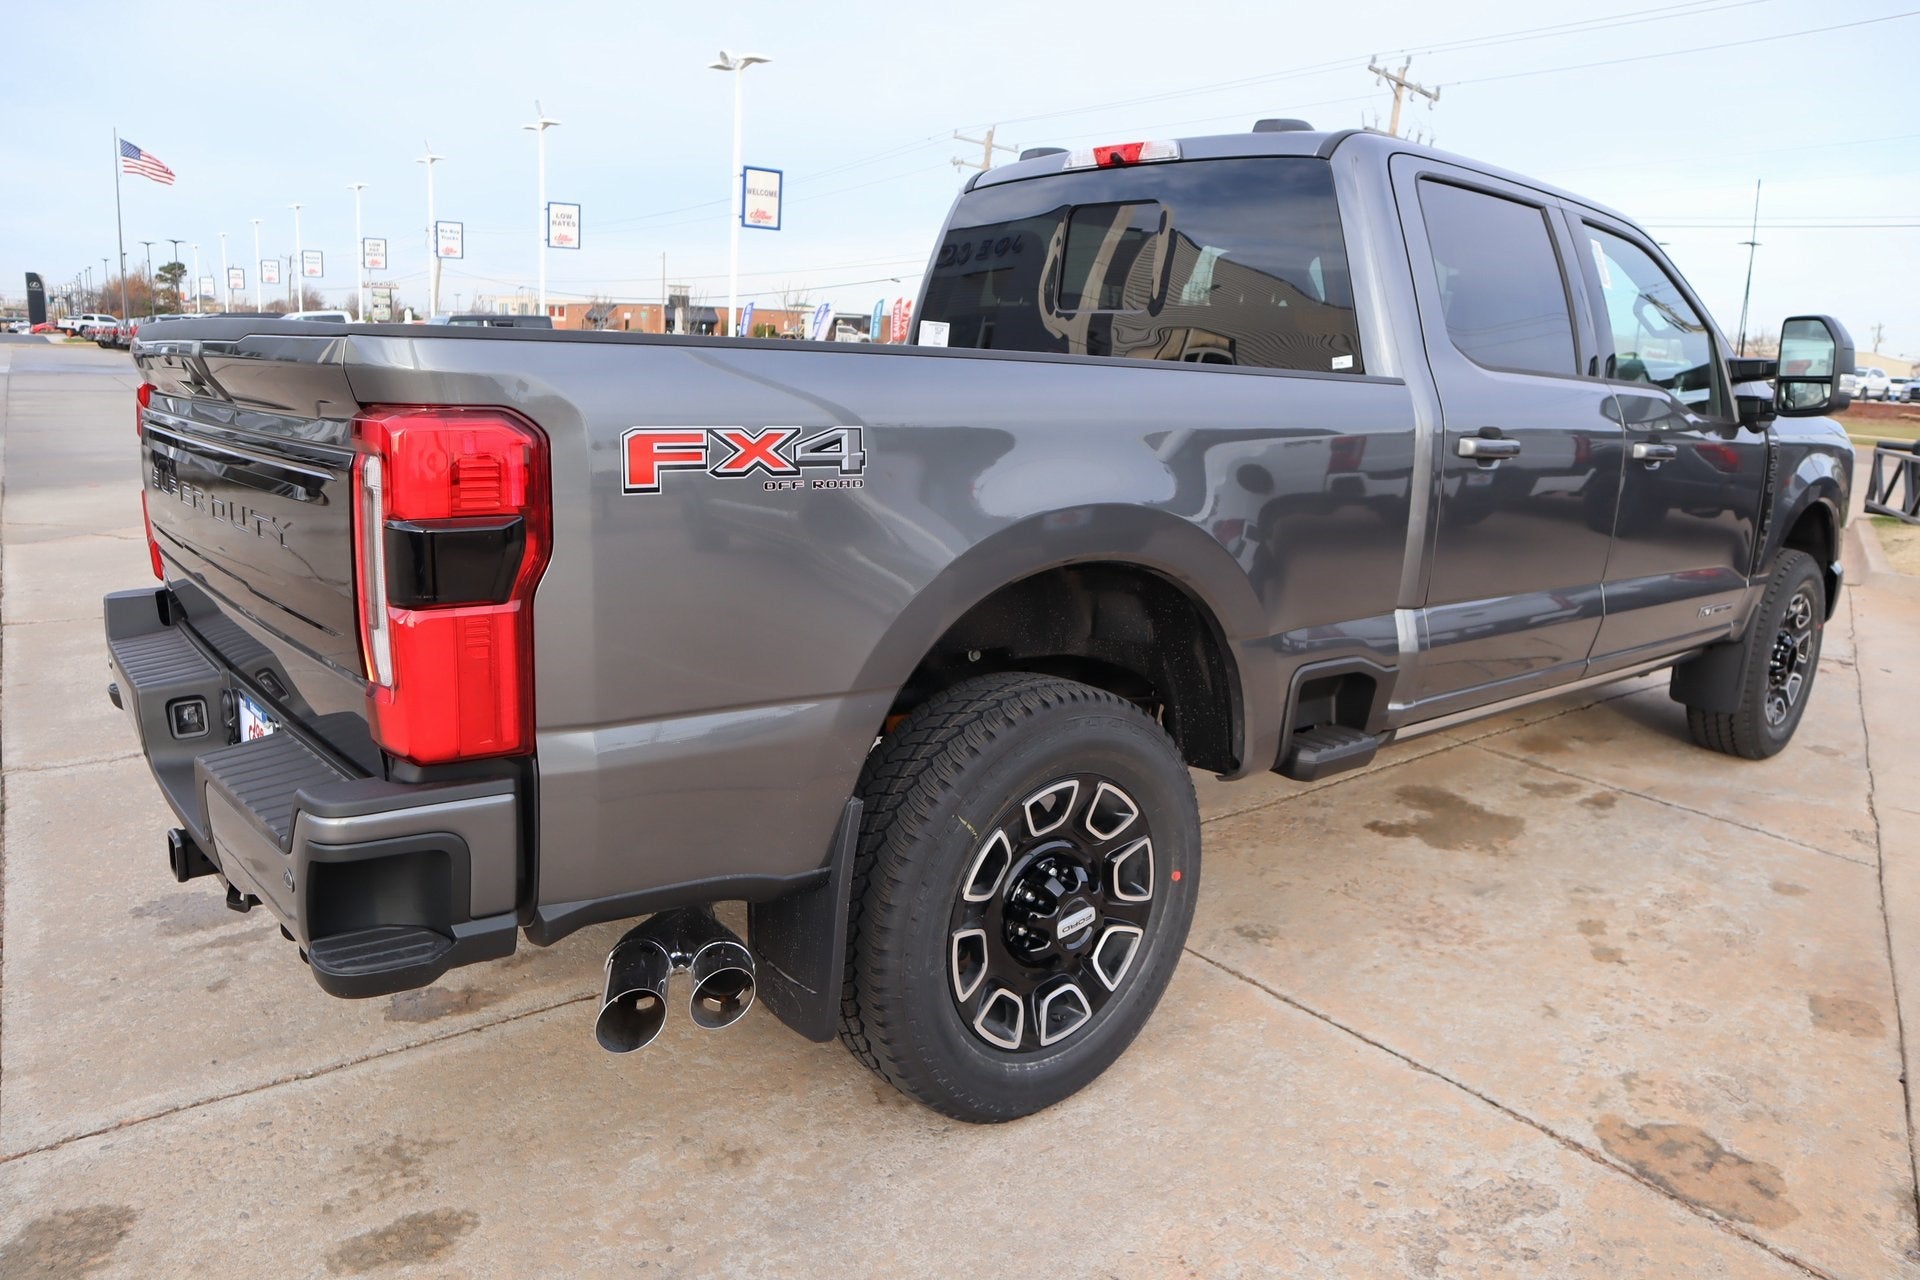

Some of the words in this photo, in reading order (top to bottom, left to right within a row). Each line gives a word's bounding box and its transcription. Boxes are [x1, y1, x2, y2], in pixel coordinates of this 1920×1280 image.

[747, 188, 778, 198] WELCOME
[620, 426, 867, 496] FX4
[763, 479, 805, 491] OFF
[812, 479, 865, 489] ROAD
[211, 494, 293, 550] DUTY
[1061, 913, 1093, 933] FORD
